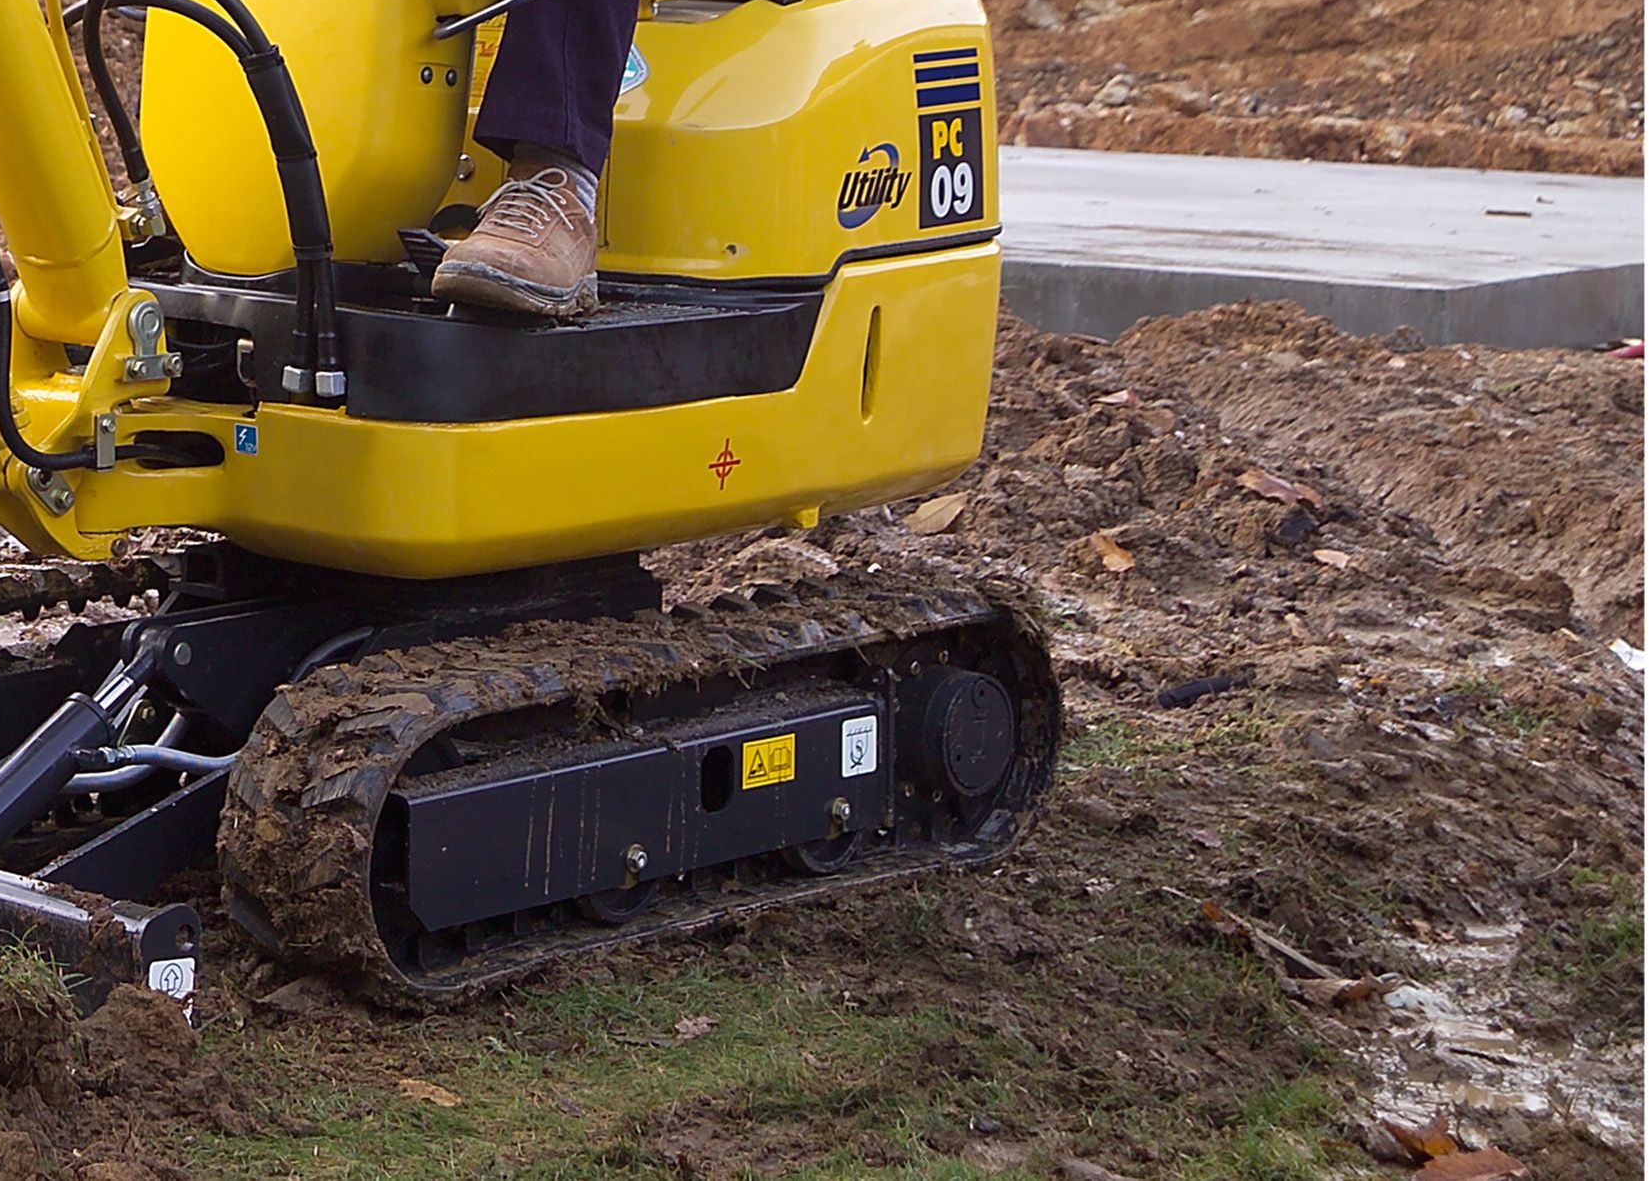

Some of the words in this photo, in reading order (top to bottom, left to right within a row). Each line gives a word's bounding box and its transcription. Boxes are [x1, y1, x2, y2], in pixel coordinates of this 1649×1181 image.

[932, 118, 963, 160] PC
[838, 167, 913, 210] Utility
[930, 162, 974, 218] 09
